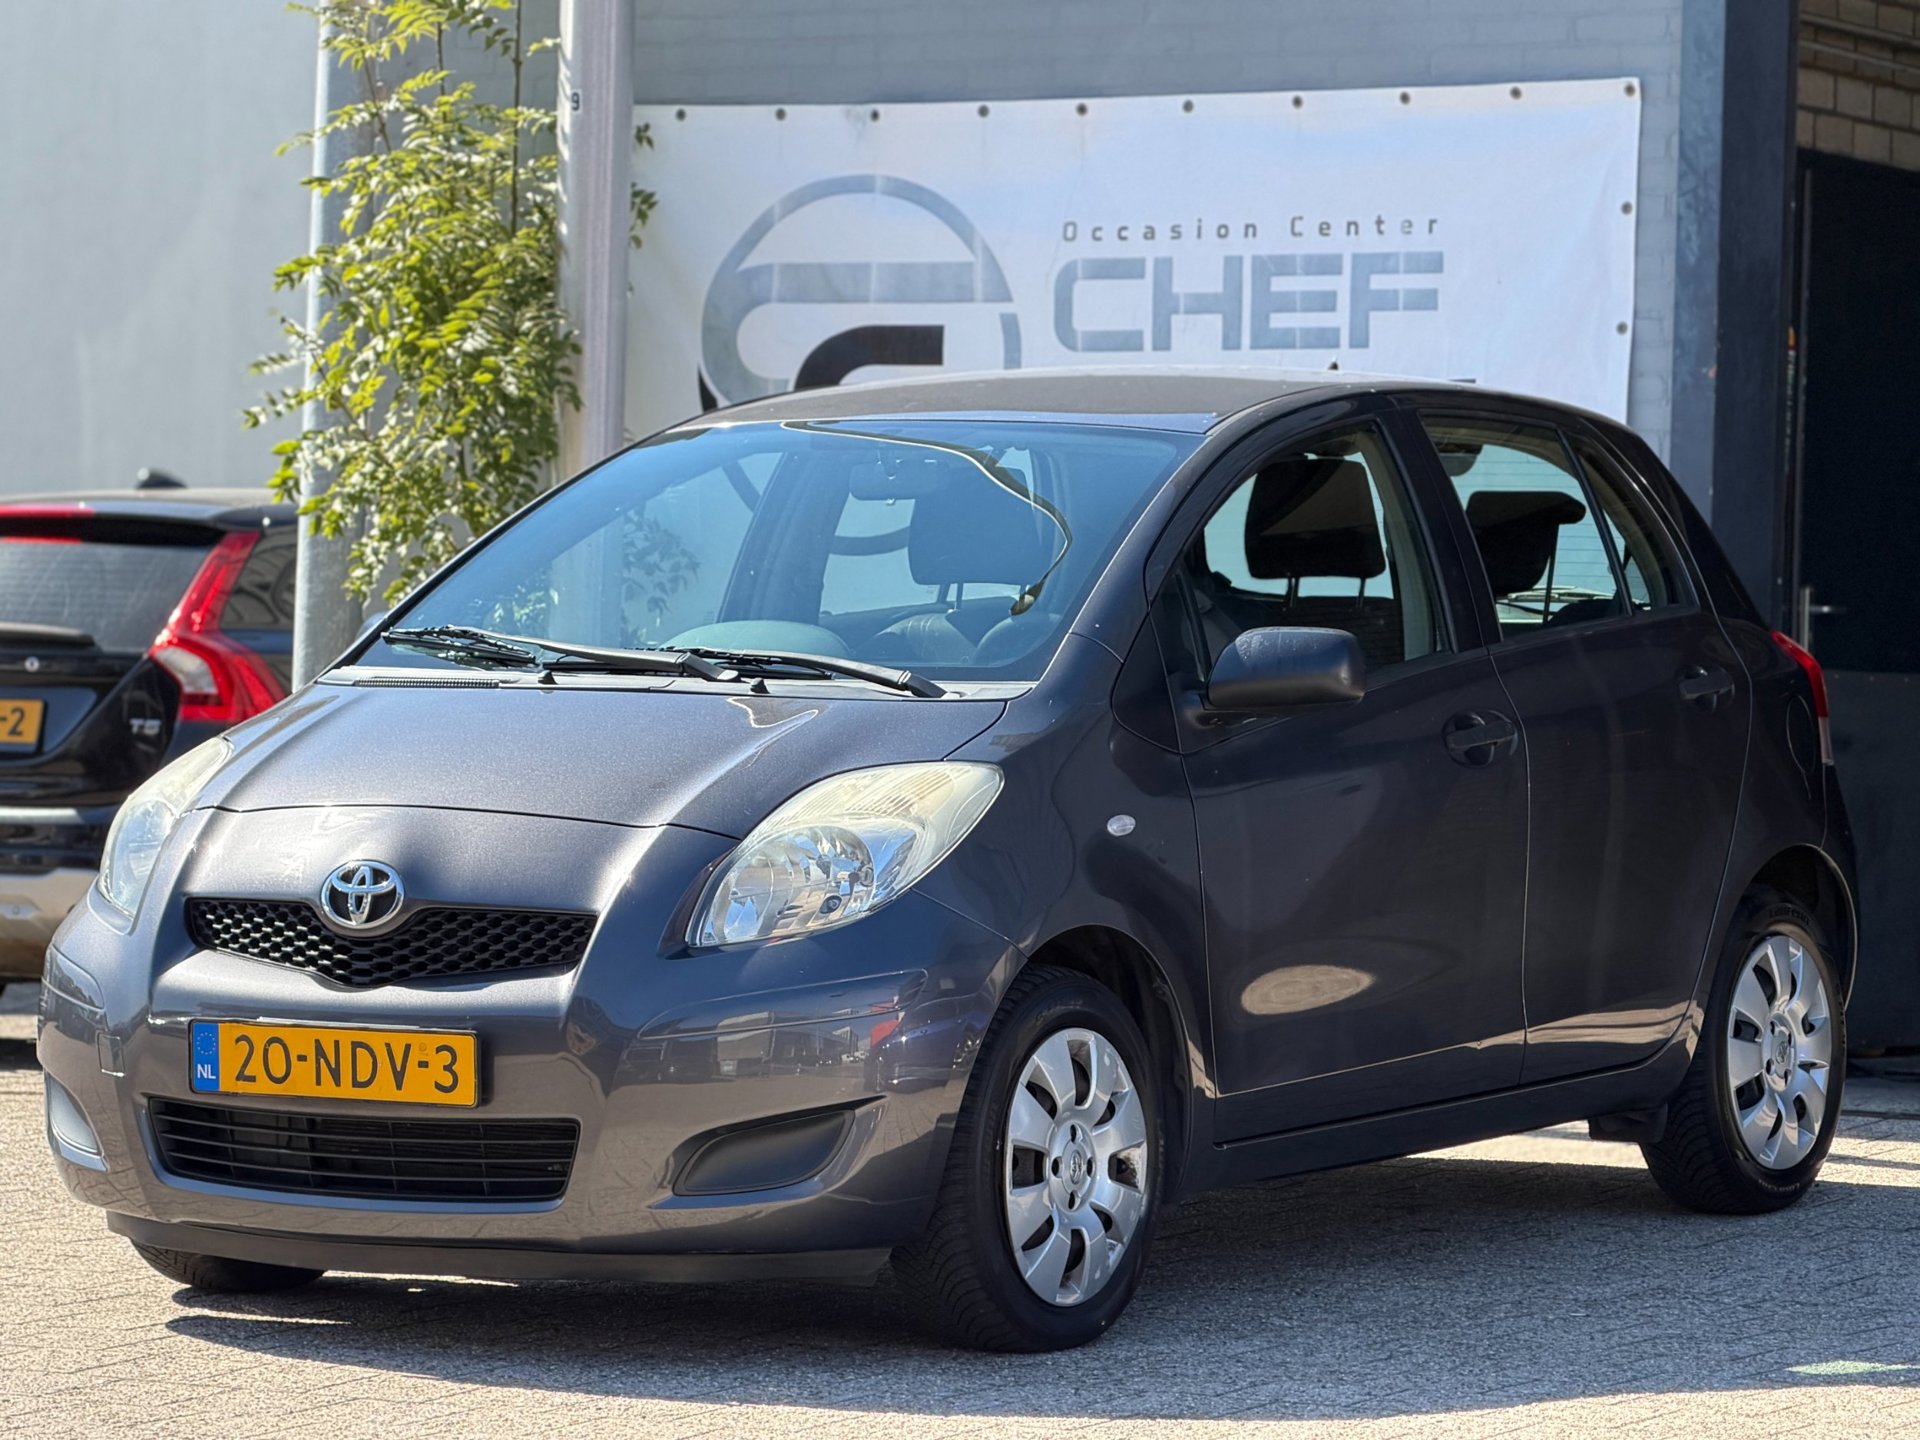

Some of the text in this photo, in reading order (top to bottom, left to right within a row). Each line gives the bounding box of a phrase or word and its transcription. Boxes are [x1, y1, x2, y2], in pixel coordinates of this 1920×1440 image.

[571, 92, 580, 111] 9
[1062, 214, 1438, 242] Occasion Center
[1054, 251, 1444, 352] CHEF
[197, 1064, 216, 1080] NL
[234, 1034, 458, 1093] 20-NDV-3
